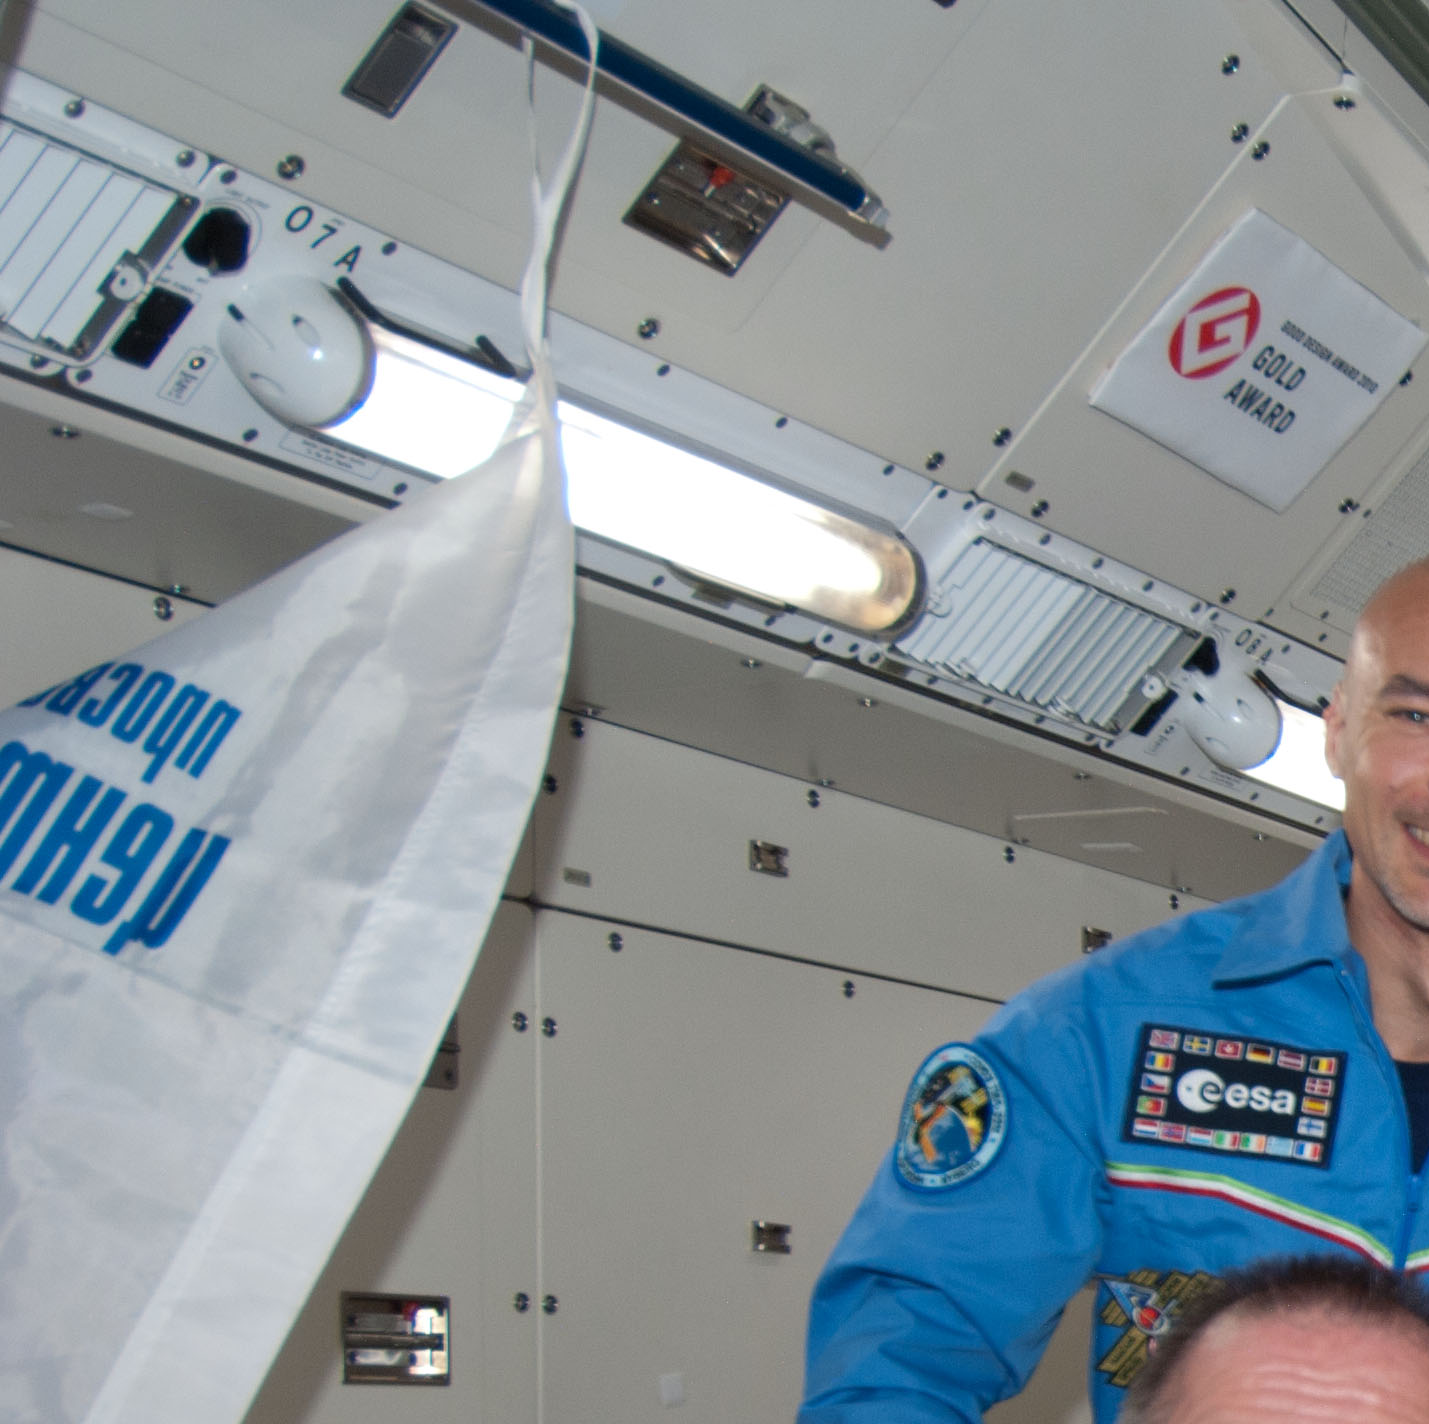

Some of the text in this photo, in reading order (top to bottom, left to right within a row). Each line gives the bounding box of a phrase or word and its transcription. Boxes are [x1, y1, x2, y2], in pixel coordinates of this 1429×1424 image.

[285, 206, 361, 272] 07A
[1252, 345, 1306, 391] GOLD
[1223, 378, 1296, 434] AWARD
[1225, 1083, 1297, 1115] esa
